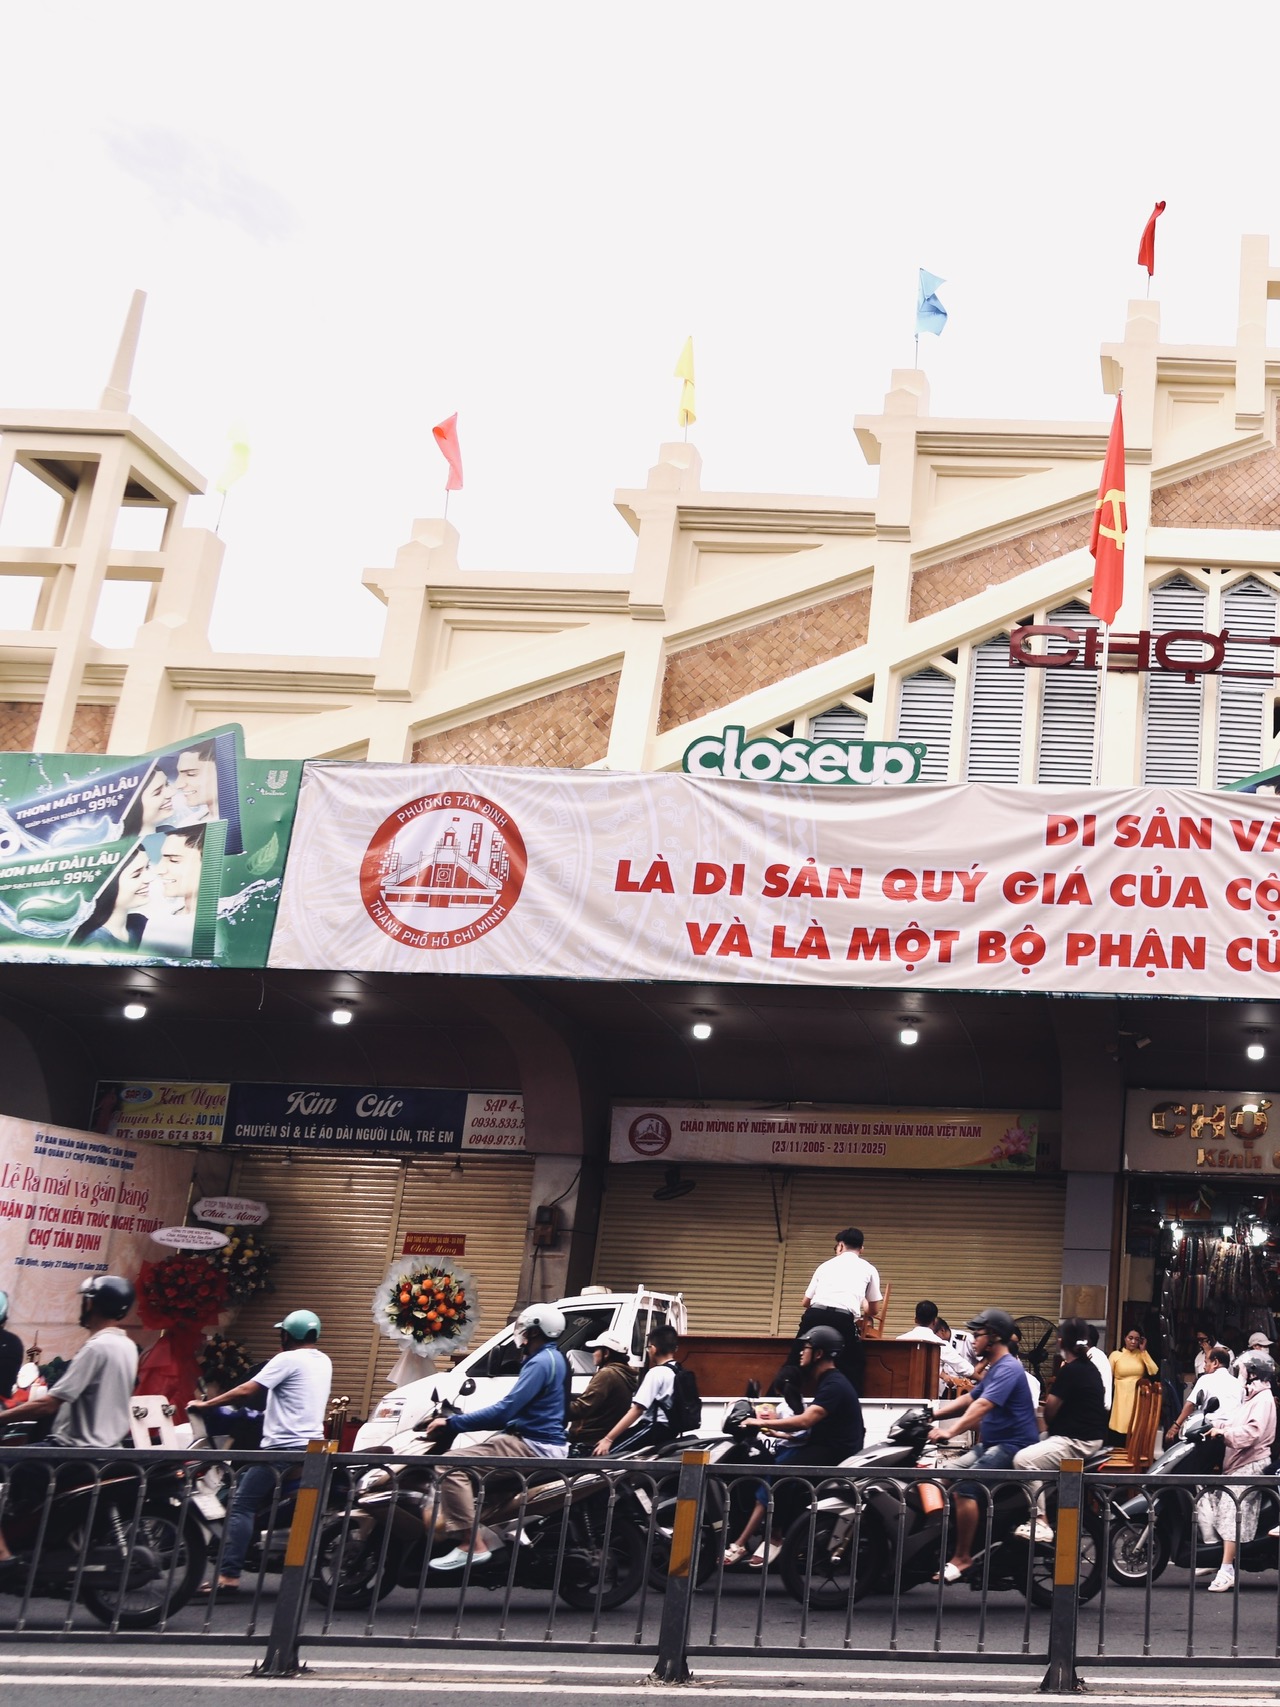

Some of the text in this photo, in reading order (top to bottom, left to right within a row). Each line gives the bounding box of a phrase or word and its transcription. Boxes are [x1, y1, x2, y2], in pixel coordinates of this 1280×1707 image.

[1010, 625, 1229, 684] CHỢ
[686, 729, 917, 785] closeup
[15, 801, 52, 820] THƠM
[52, 793, 82, 810] MÁT
[82, 784, 107, 802] DÀI
[108, 776, 139, 795] LÂU
[396, 794, 508, 827] PHƯỜNG TÂN ĐỊNH
[1045, 813, 1097, 847] DI
[1114, 806, 1212, 850] SẢN
[0, 851, 121, 879] HƠM MÁT DÀI LÂU
[615, 854, 675, 894] LÀ
[692, 862, 746, 897] DI
[762, 857, 864, 899] SẢN
[882, 863, 988, 903] QUÝ
[1002, 865, 1093, 905] GIÁ
[1110, 865, 1209, 910] CỦA
[369, 899, 507, 947] THÀNH PHỐ HỒ CHÍ MINH
[686, 916, 753, 958] VÀ
[770, 919, 831, 960] LÀ
[846, 921, 960, 972] MỘT
[977, 924, 1046, 975] BỘ
[1065, 928, 1206, 978] PHẬN
[156, 1087, 186, 1105] Kim
[285, 1091, 404, 1118] Kim Cúc
[484, 1099, 507, 1115] SẠP
[166, 1115, 173, 1124] &
[195, 1113, 207, 1125] ÁO
[235, 1121, 454, 1144] CHUYÊN SỈ & LẺ ÁO DÀI NGƯỜI LỚN, TRẺ EM
[680, 1118, 982, 1140] CHÀO MỪNG KỶ NIỆM LẦN THỨ XX NGÀY DI SẢN VĂN HÓA VIỆT NAM
[1150, 1099, 1273, 1149] CHỢ
[137, 1129, 164, 1139] 0902
[168, 1130, 189, 1140] 674
[192, 1131, 213, 1141] 834
[772, 1141, 825, 1154] (23/11/2005
[833, 1141, 887, 1156] 23/11/2025)
[1196, 1148, 1262, 1169] Kính
[1, 1163, 149, 1214] Lễ Ra mắt và gắn bảng
[0, 1199, 22, 1221] HẬN
[25, 1204, 36, 1220] DI
[38, 1203, 59, 1223] TÍCH
[62, 1204, 85, 1226] KIẾN
[87, 1209, 109, 1229] TRÚC
[110, 1215, 134, 1235] NGHỆ
[28, 1227, 102, 1254] CHỢ TÂN ĐỊNH
